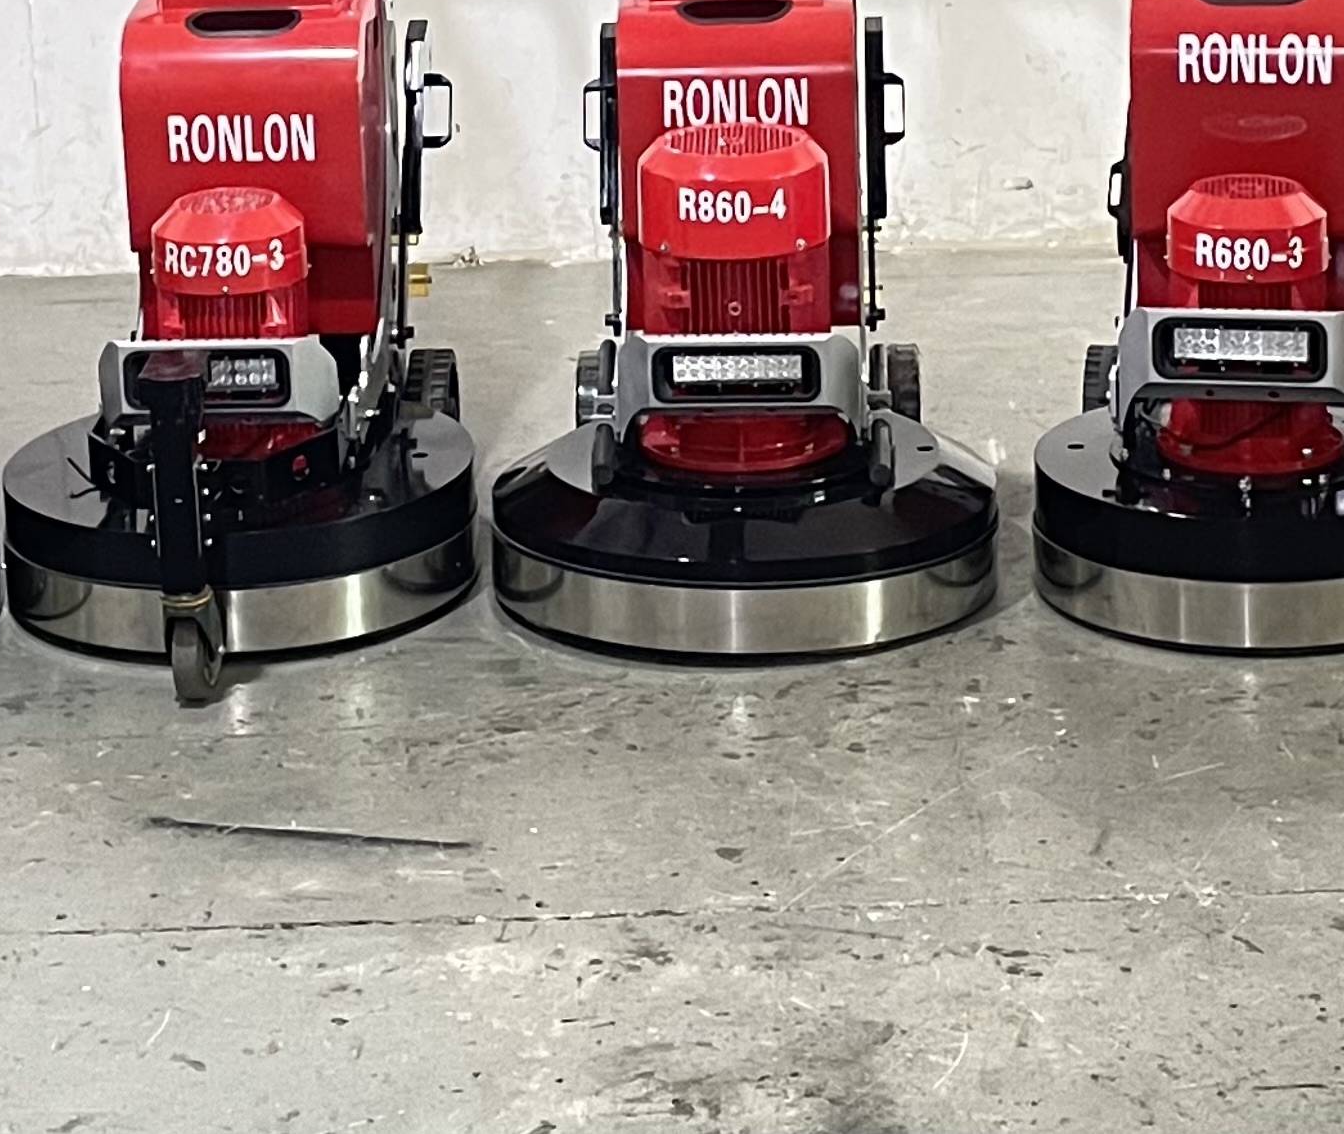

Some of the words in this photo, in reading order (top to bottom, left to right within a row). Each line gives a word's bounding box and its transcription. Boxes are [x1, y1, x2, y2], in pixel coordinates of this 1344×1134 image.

[1177, 32, 1334, 85] RONLON
[663, 77, 808, 129] RONLON
[167, 113, 316, 163] RONLON
[678, 186, 787, 224] R860-4
[164, 238, 285, 278] RC780-3
[1195, 232, 1306, 271] R680-3
